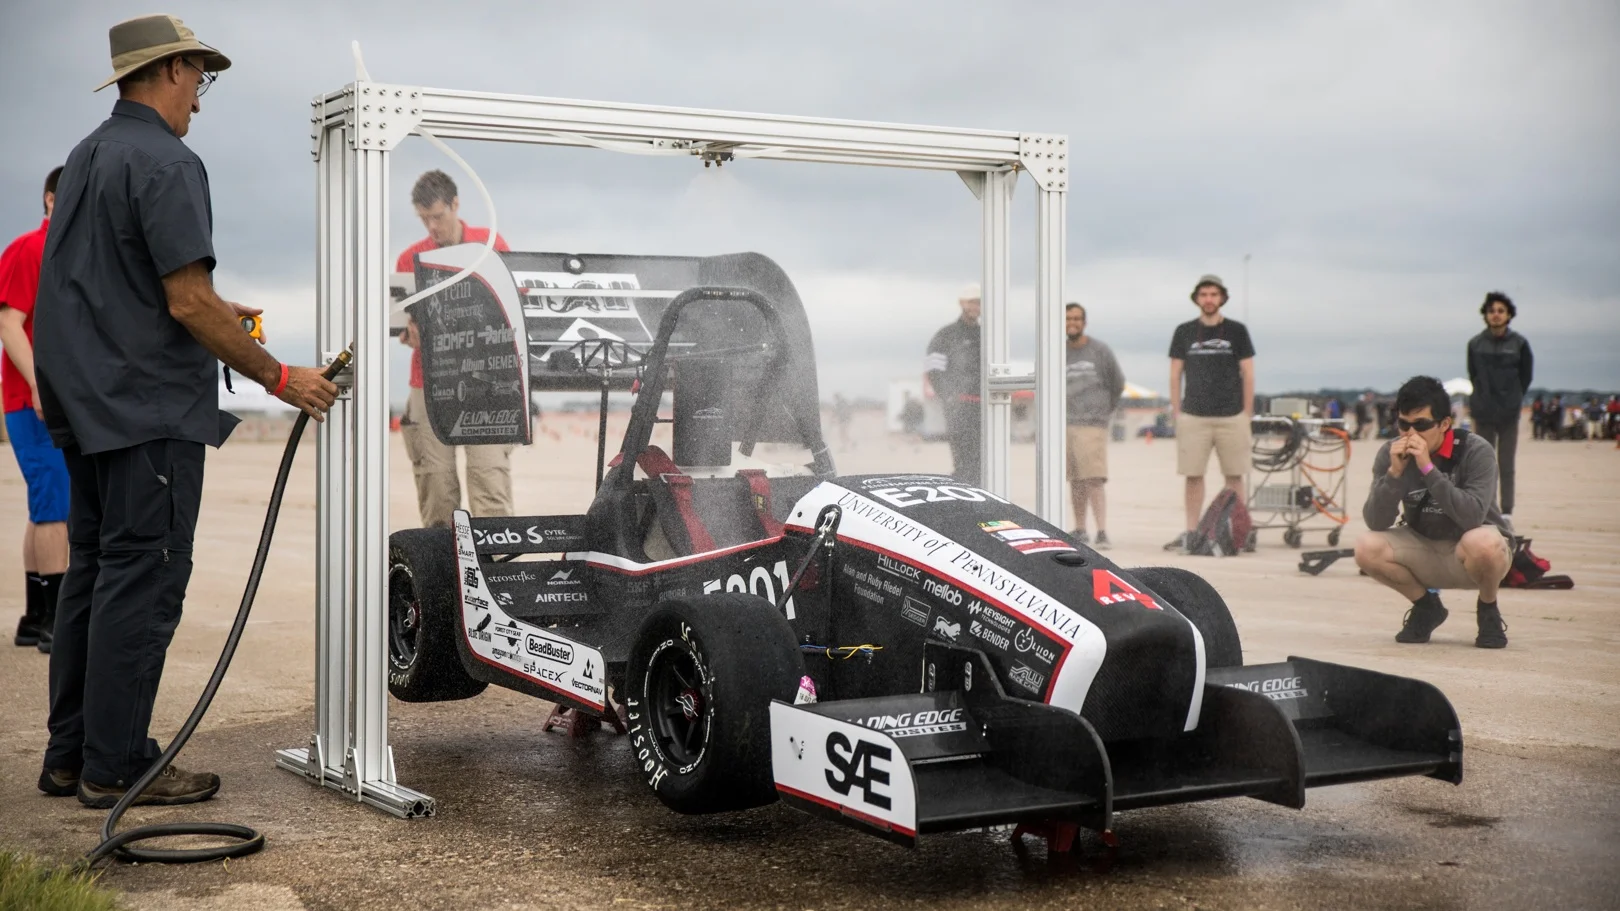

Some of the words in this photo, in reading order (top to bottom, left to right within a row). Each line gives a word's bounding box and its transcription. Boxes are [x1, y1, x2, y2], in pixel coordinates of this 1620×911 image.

[487, 353, 524, 371] SIEMENS
[461, 426, 517, 436] COMPOSITES
[837, 491, 927, 543] UNIVERSITY
[923, 538, 955, 557] of
[950, 550, 1083, 640] PENNSYLVANIA
[855, 570, 867, 582] and
[535, 592, 588, 603] AIRTECH
[982, 606, 1016, 629] KEYSIGHT
[982, 628, 1010, 651] BENDER
[528, 638, 571, 661] BeadBuster
[571, 677, 603, 696] VECTORNAV
[1262, 676, 1302, 692] EDGE
[848, 713, 912, 729] DING
[913, 708, 964, 726] EDGE
[890, 723, 963, 737] OSITES
[824, 731, 892, 811] SAE
